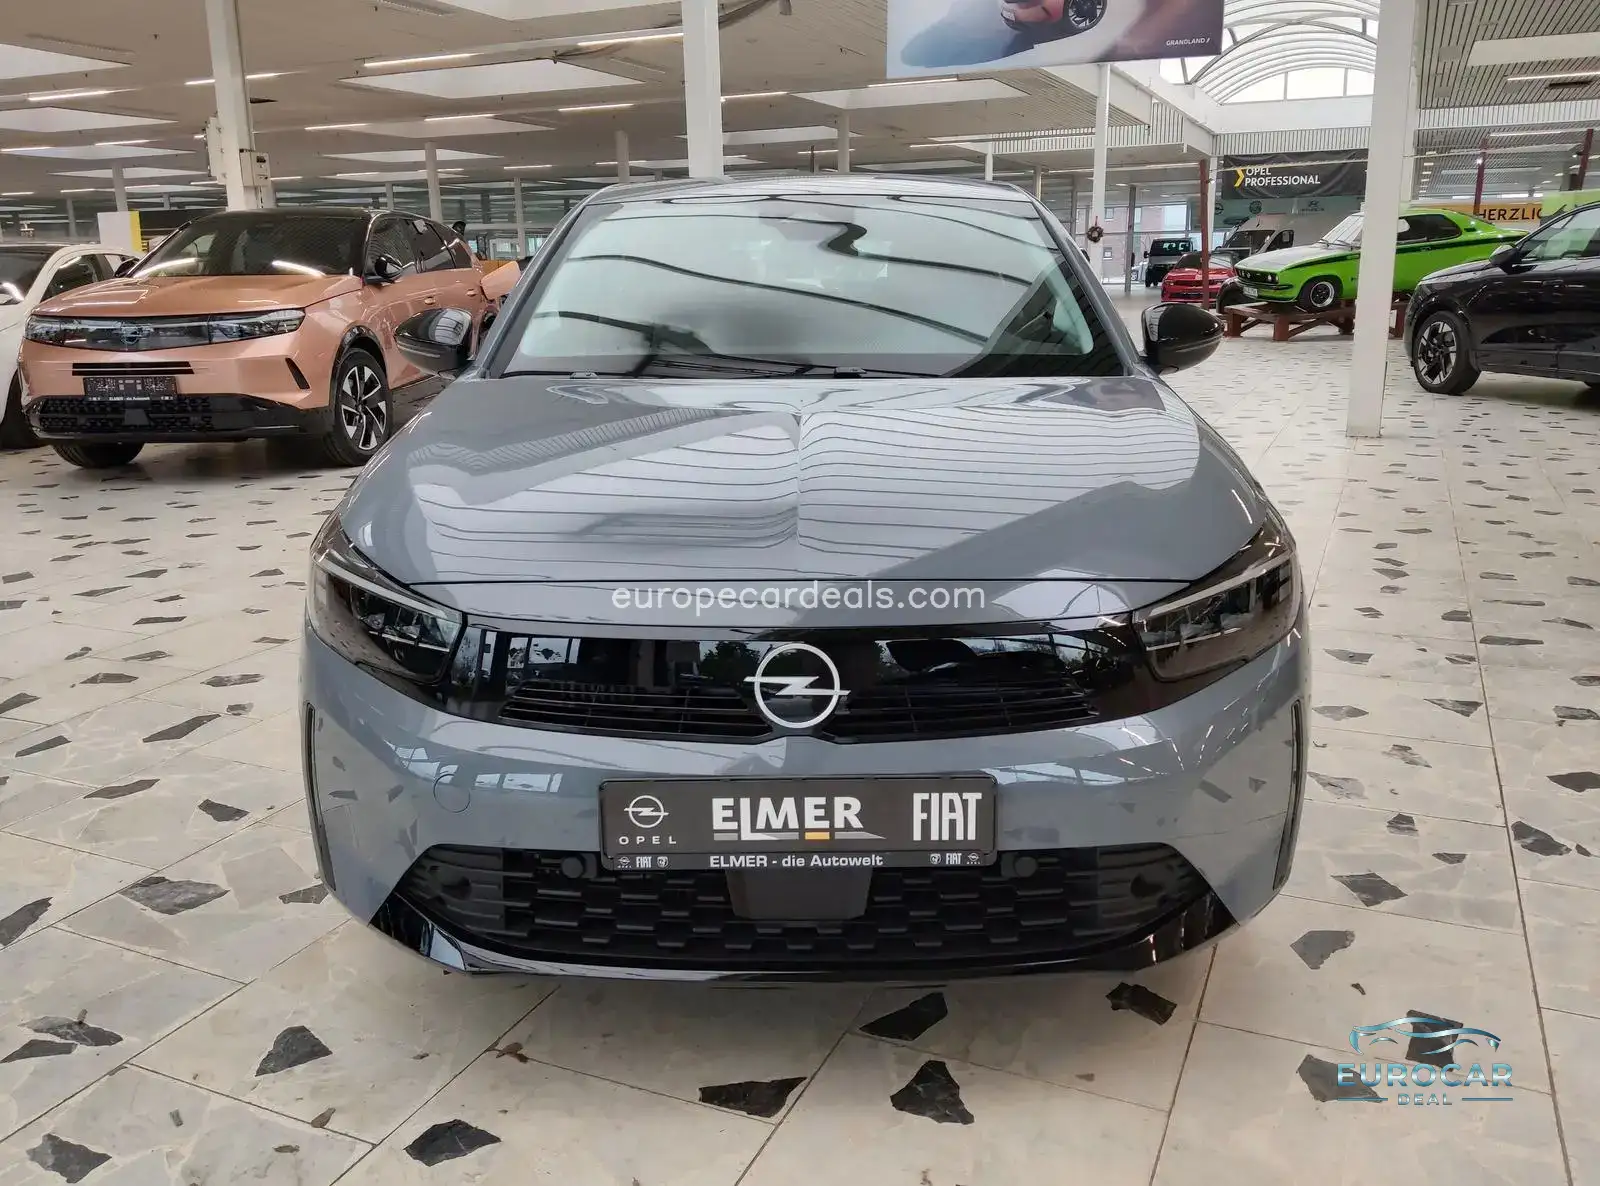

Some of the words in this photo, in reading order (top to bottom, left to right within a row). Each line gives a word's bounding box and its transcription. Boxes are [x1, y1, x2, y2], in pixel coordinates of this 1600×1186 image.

[1166, 38, 1206, 46] GRANDLAND
[1246, 167, 1271, 176] OPEL
[1245, 175, 1320, 187] PROFESSIONAL
[712, 797, 864, 840] ELMER
[913, 792, 982, 840] FIAT
[618, 836, 677, 845] OPEL
[636, 856, 652, 868] FIAT
[709, 855, 768, 867] ELMER
[782, 855, 804, 867] die
[810, 854, 884, 866] Autowelt
[946, 852, 962, 865] FIAT
